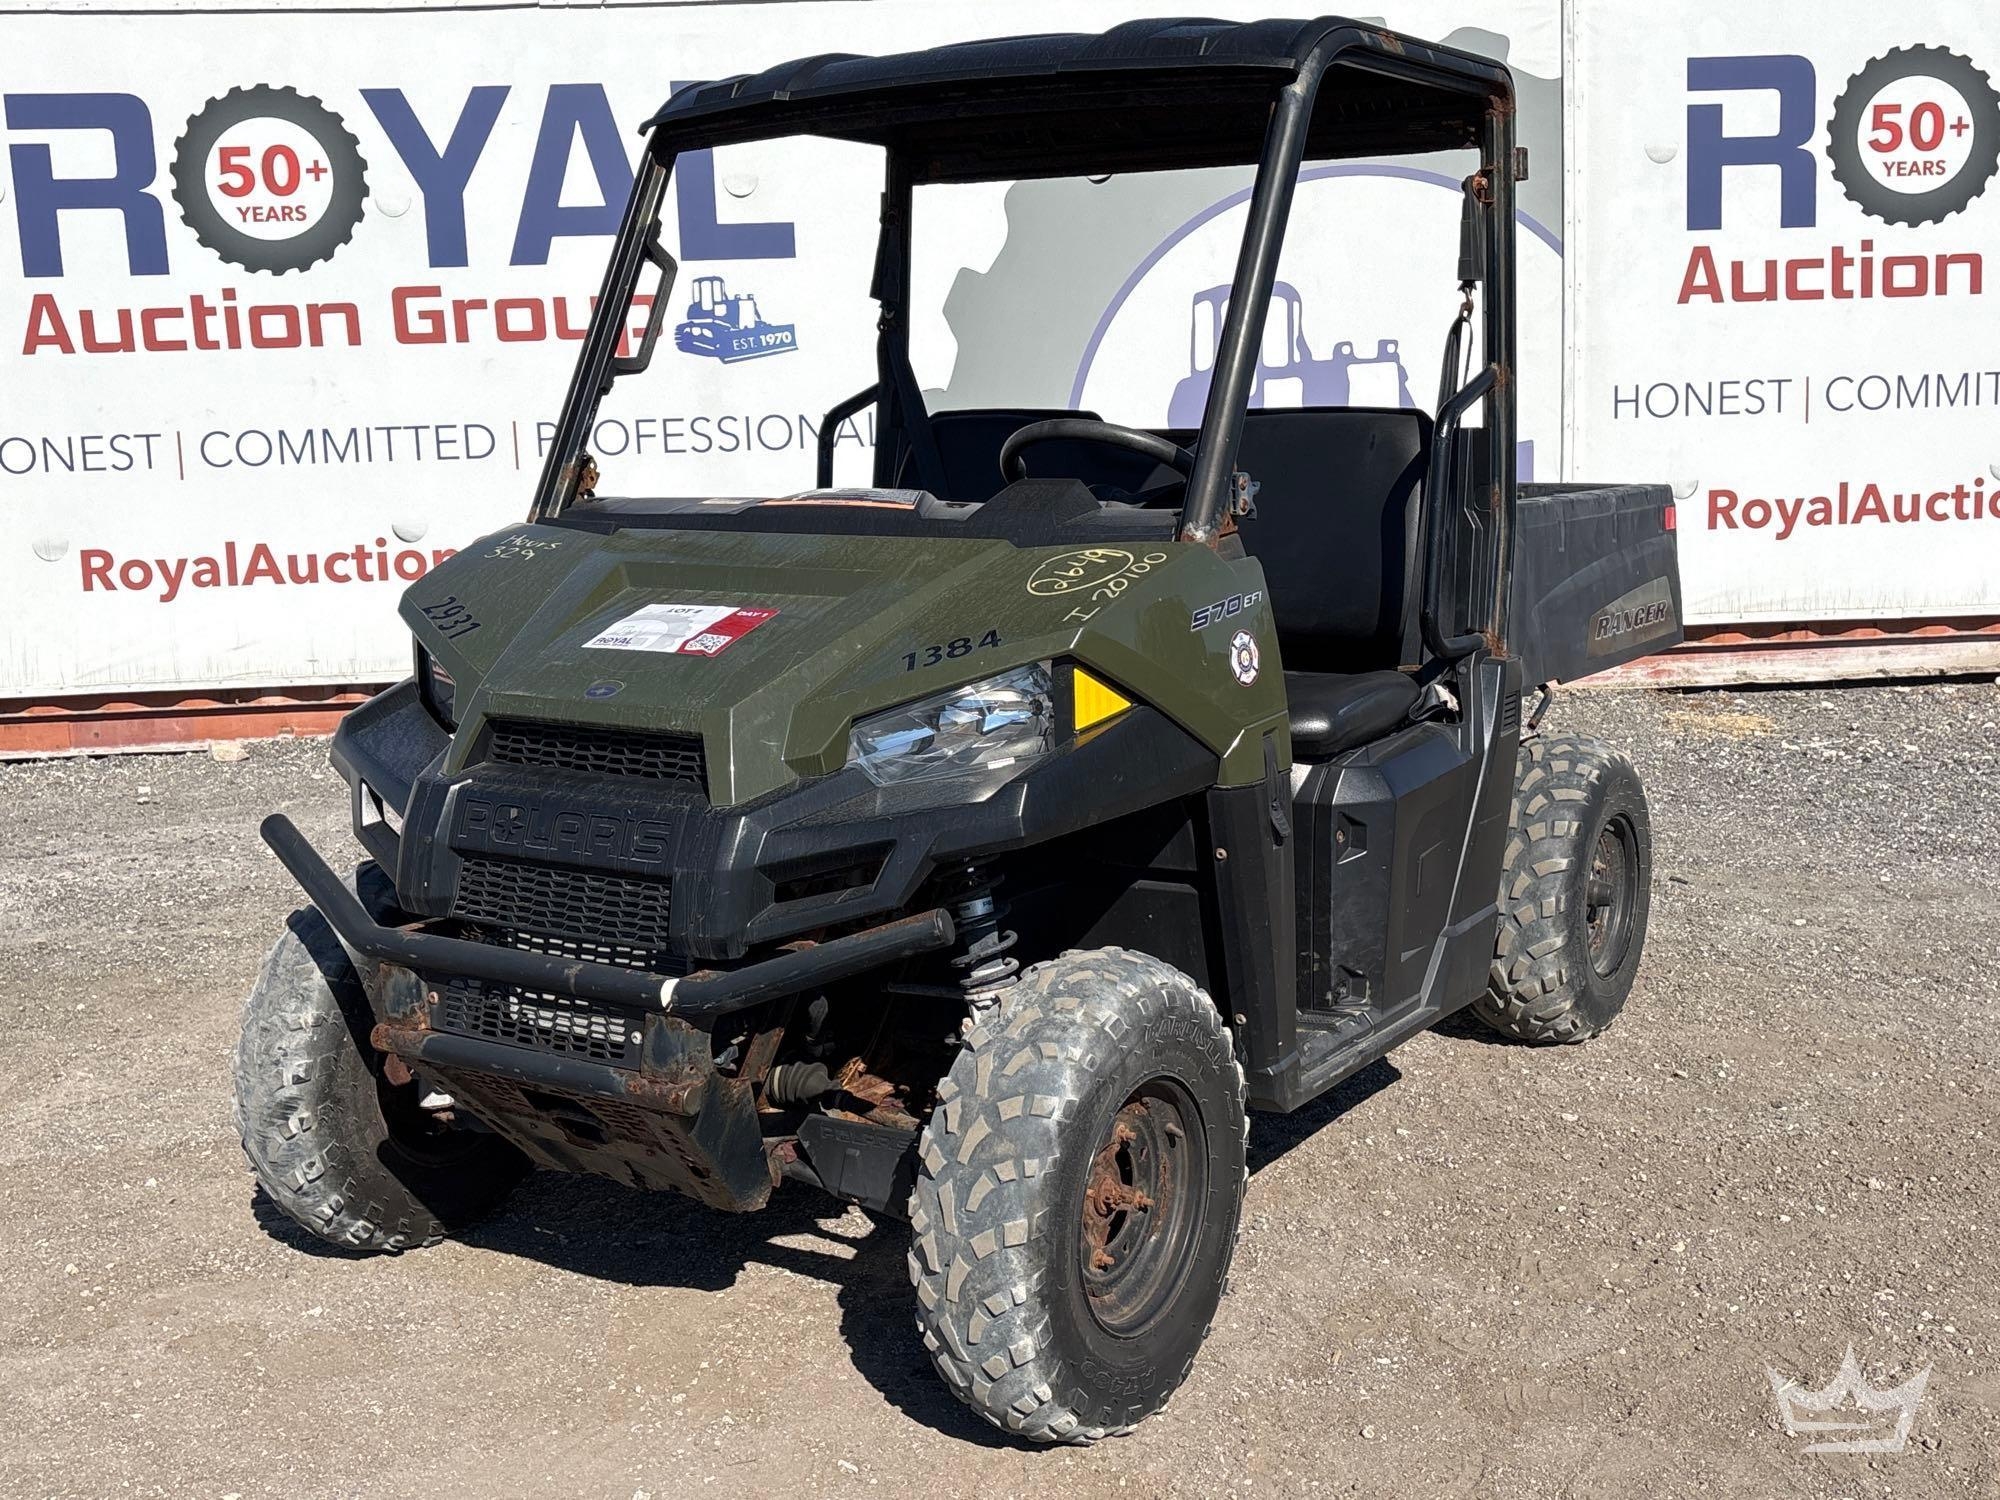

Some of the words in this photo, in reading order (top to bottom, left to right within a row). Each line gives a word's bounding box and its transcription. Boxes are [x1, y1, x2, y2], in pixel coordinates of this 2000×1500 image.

[1867, 101, 1970, 154] 50+
[3, 79, 797, 277] ROYAL
[216, 142, 330, 196] 50+
[1883, 159, 1947, 178] YEARS
[236, 203, 308, 225] YEARS
[1677, 239, 1983, 305] Auction
[22, 287, 362, 356] Auction
[732, 337, 758, 351] EST.
[759, 331, 793, 347] 1970
[1614, 379, 1793, 420] HONEST
[200, 423, 496, 468] COMMITTED
[535, 411, 877, 458] POFESSIONAL
[421, 595, 482, 640] 2931
[1190, 593, 1243, 632] 570
[1243, 590, 1262, 608] EFI
[1594, 599, 1668, 641] RANGER
[901, 629, 1003, 672] 1384
[457, 799, 673, 864] POLARIS
